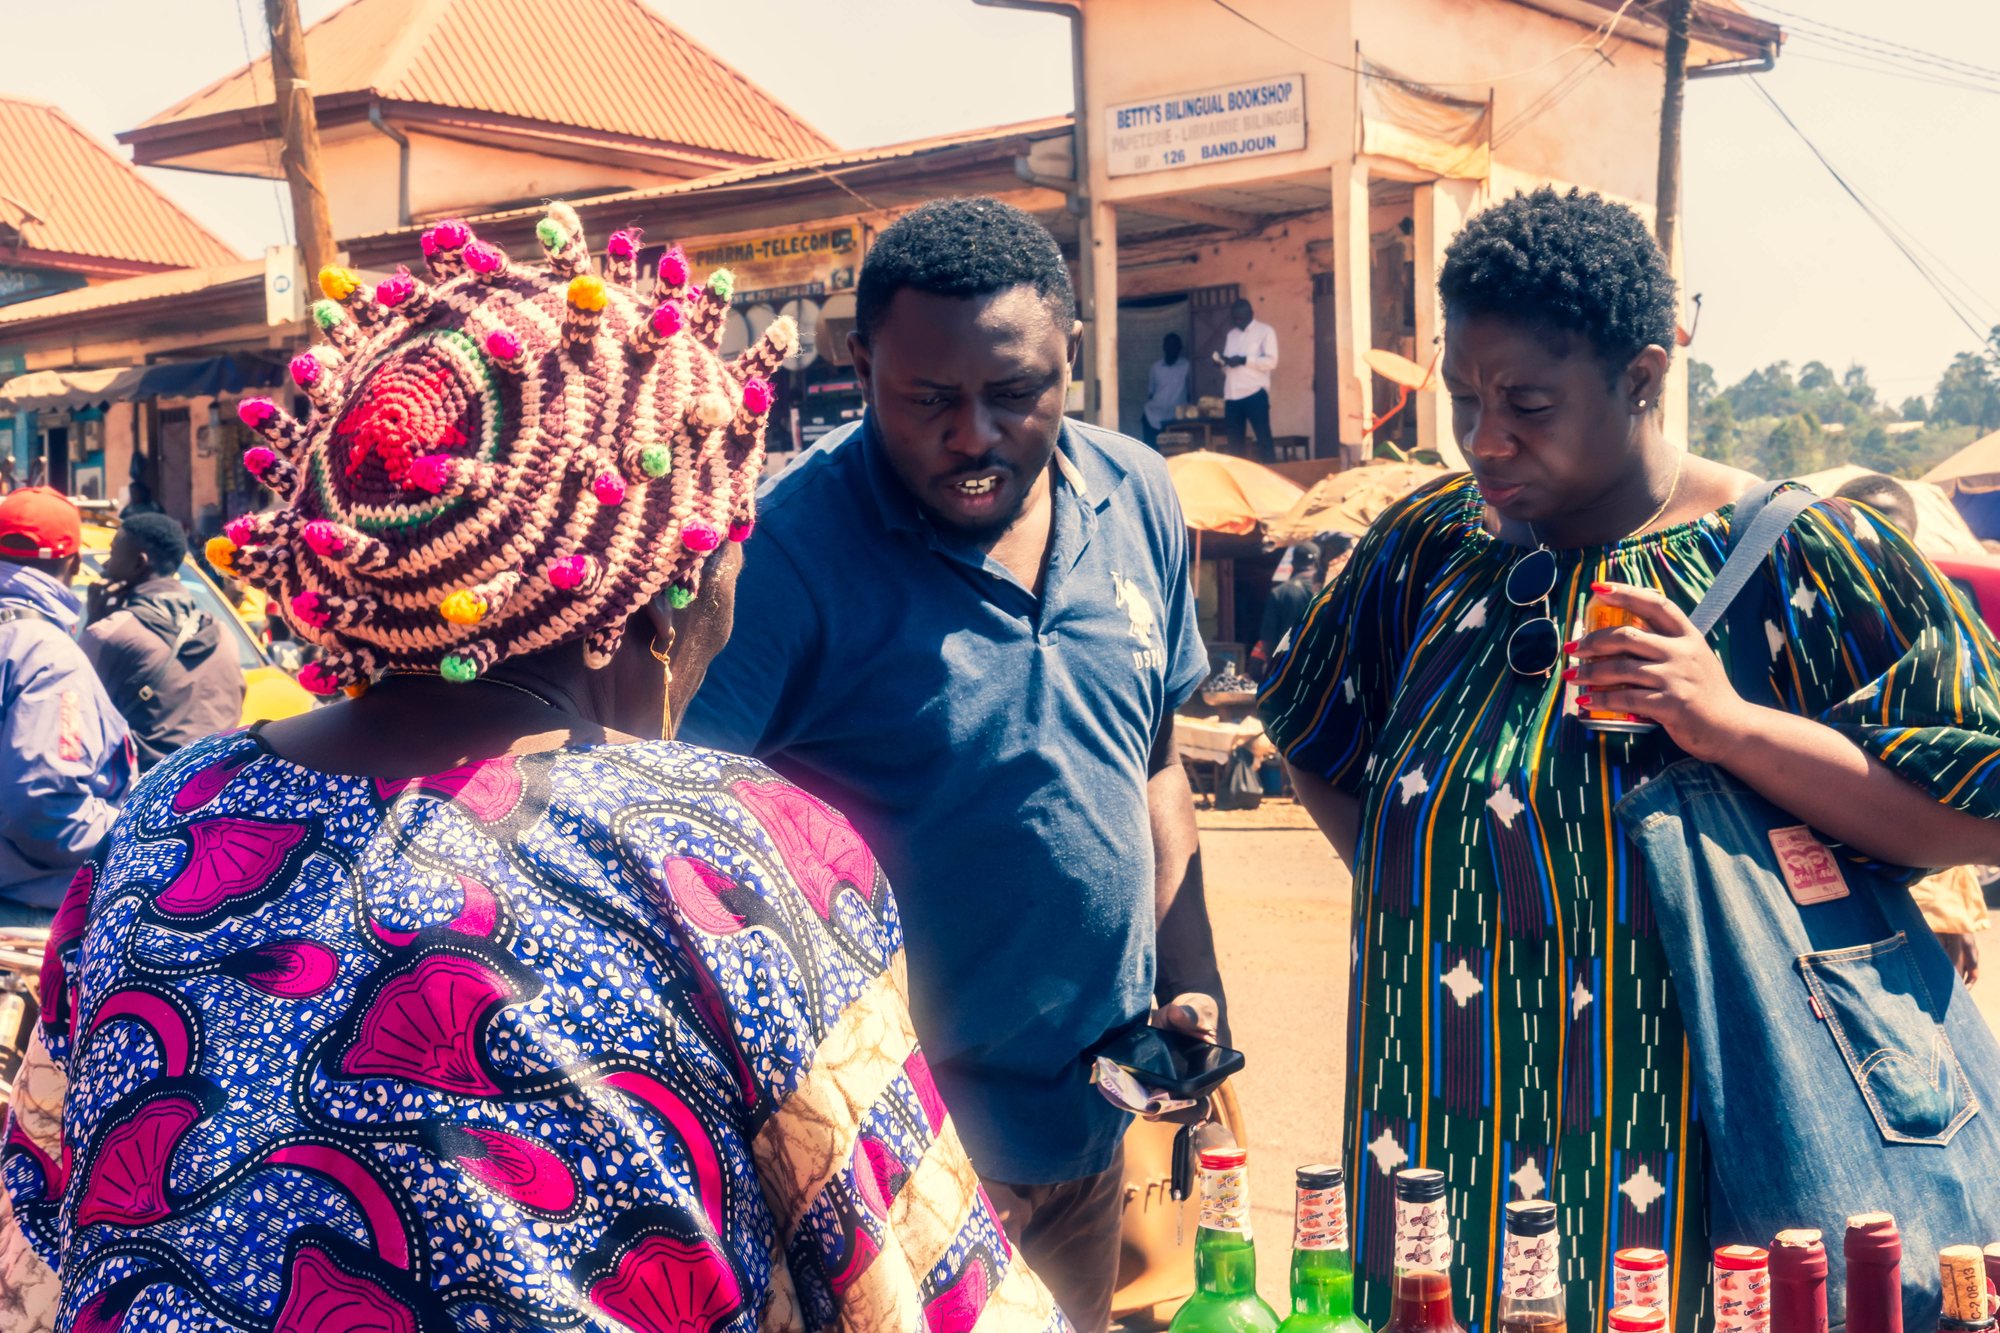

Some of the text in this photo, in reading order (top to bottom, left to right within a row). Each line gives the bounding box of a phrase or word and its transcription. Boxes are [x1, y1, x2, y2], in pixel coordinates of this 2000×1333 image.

[1117, 82, 1292, 129] BETTY'S BILINGUAL BOOKSHOP
[1111, 128, 1171, 151] PAPETERIE
[1243, 107, 1300, 126] BILINGUE
[1163, 150, 1185, 165] 126
[1201, 135, 1276, 159] BANDJOUN
